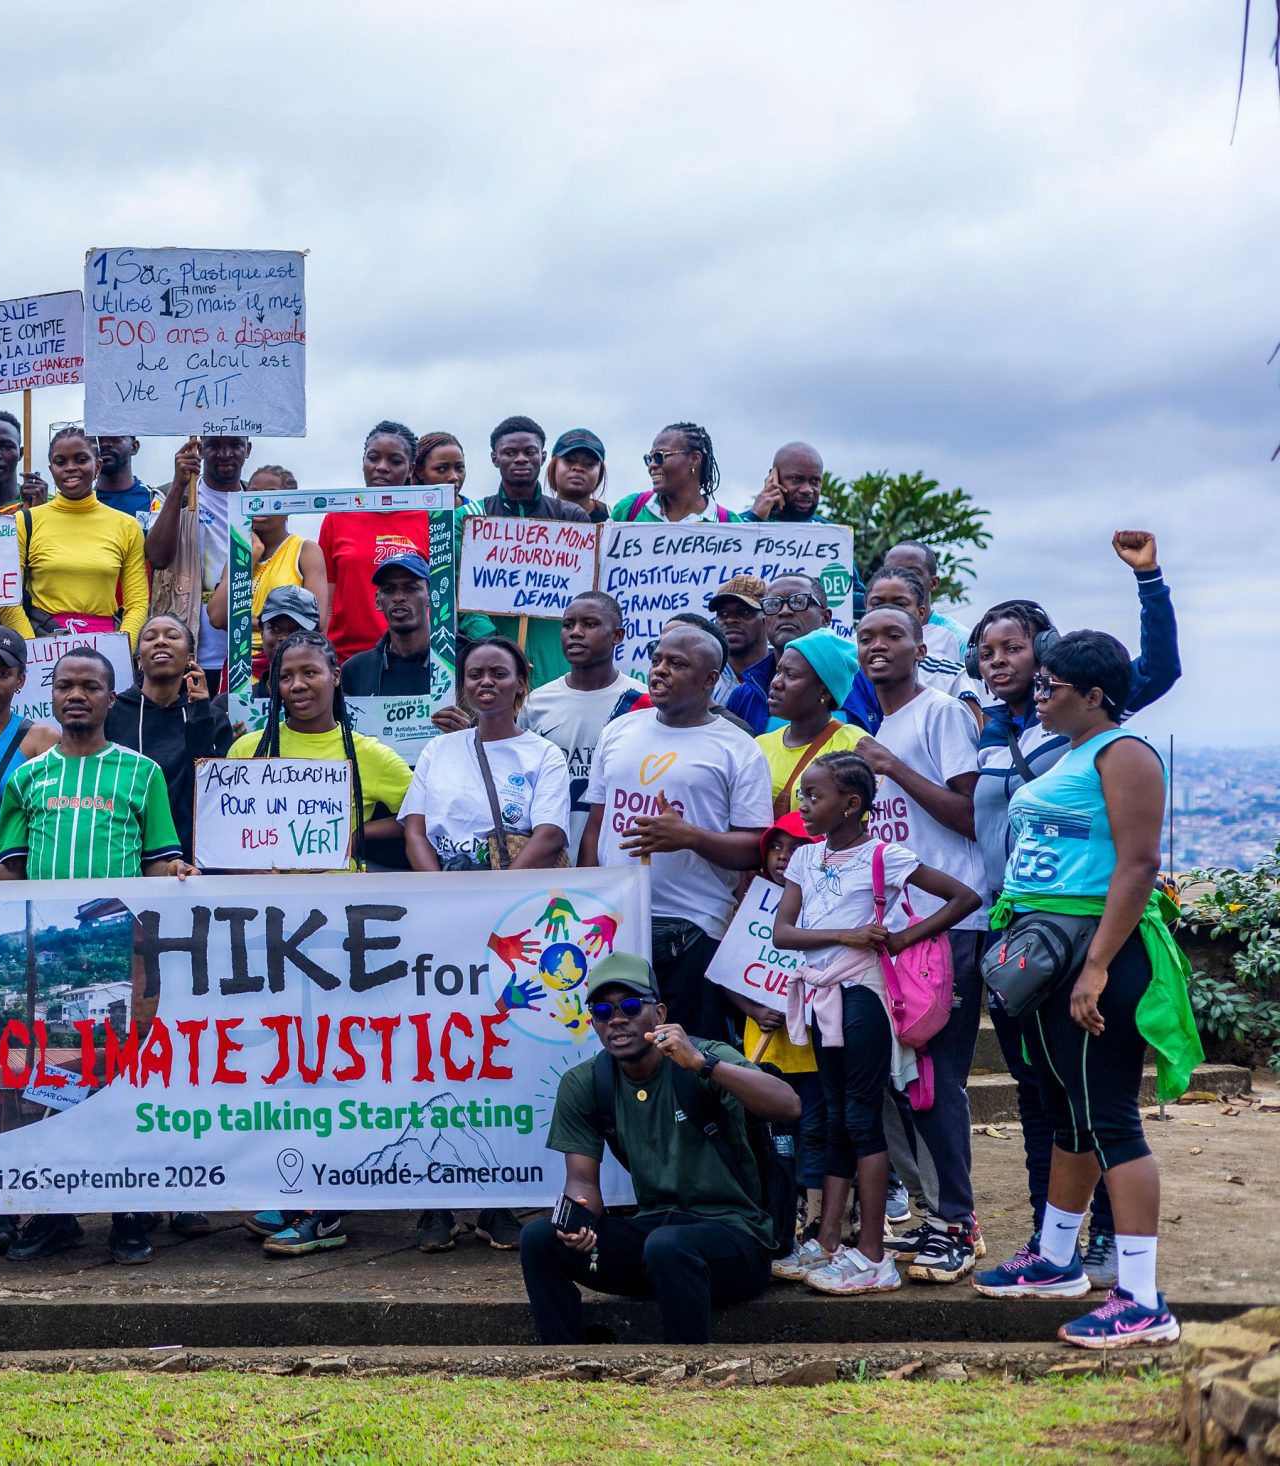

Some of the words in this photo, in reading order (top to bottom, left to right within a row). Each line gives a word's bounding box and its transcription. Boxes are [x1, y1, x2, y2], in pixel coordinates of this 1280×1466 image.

[94, 252, 108, 285] 1
[266, 262, 297, 279] est
[191, 284, 217, 295] mins
[160, 286, 193, 318] 15
[197, 295, 236, 315] mais
[18, 318, 66, 340] COMPTE
[98, 316, 156, 346] 500
[167, 326, 209, 344] ans
[216, 327, 228, 343] à
[7, 345, 23, 359] LA
[27, 338, 66, 356] LUTTE
[136, 343, 169, 371] Le
[259, 355, 292, 368] est
[12, 361, 31, 376] LES
[429, 522, 446, 534] Stop
[429, 531, 451, 543] alking
[472, 519, 549, 545] POLLUER
[555, 527, 595, 551] MOINS
[429, 541, 450, 555] Start
[607, 531, 642, 560] LES
[653, 535, 743, 556] ENERGIES
[754, 537, 840, 560] FOSSILES
[429, 553, 452, 566] Acting
[231, 579, 252, 591] Talking
[234, 571, 249, 581] Stop
[473, 567, 521, 589] VIVRE
[525, 570, 570, 590] MIEUX
[606, 564, 716, 592] CONSTITUENT
[232, 598, 252, 611] Acting
[233, 589, 251, 600] Start
[615, 592, 689, 615] GRANDES
[47, 796, 114, 813] ROBOGA
[221, 793, 256, 816] POUR
[267, 797, 287, 815] UN
[242, 828, 279, 849] PLUS
[288, 816, 344, 857] VERT
[133, 903, 409, 998] HIKE
[411, 953, 490, 996] for
[260, 1012, 515, 1085] JUSTICE
[136, 1103, 212, 1139] Stop
[218, 1101, 332, 1138] talking
[338, 1100, 424, 1130] Start
[429, 1098, 533, 1135] acting
[8, 1168, 38, 1190] 26
[40, 1167, 160, 1194] Septembre
[164, 1165, 226, 1188] 2026
